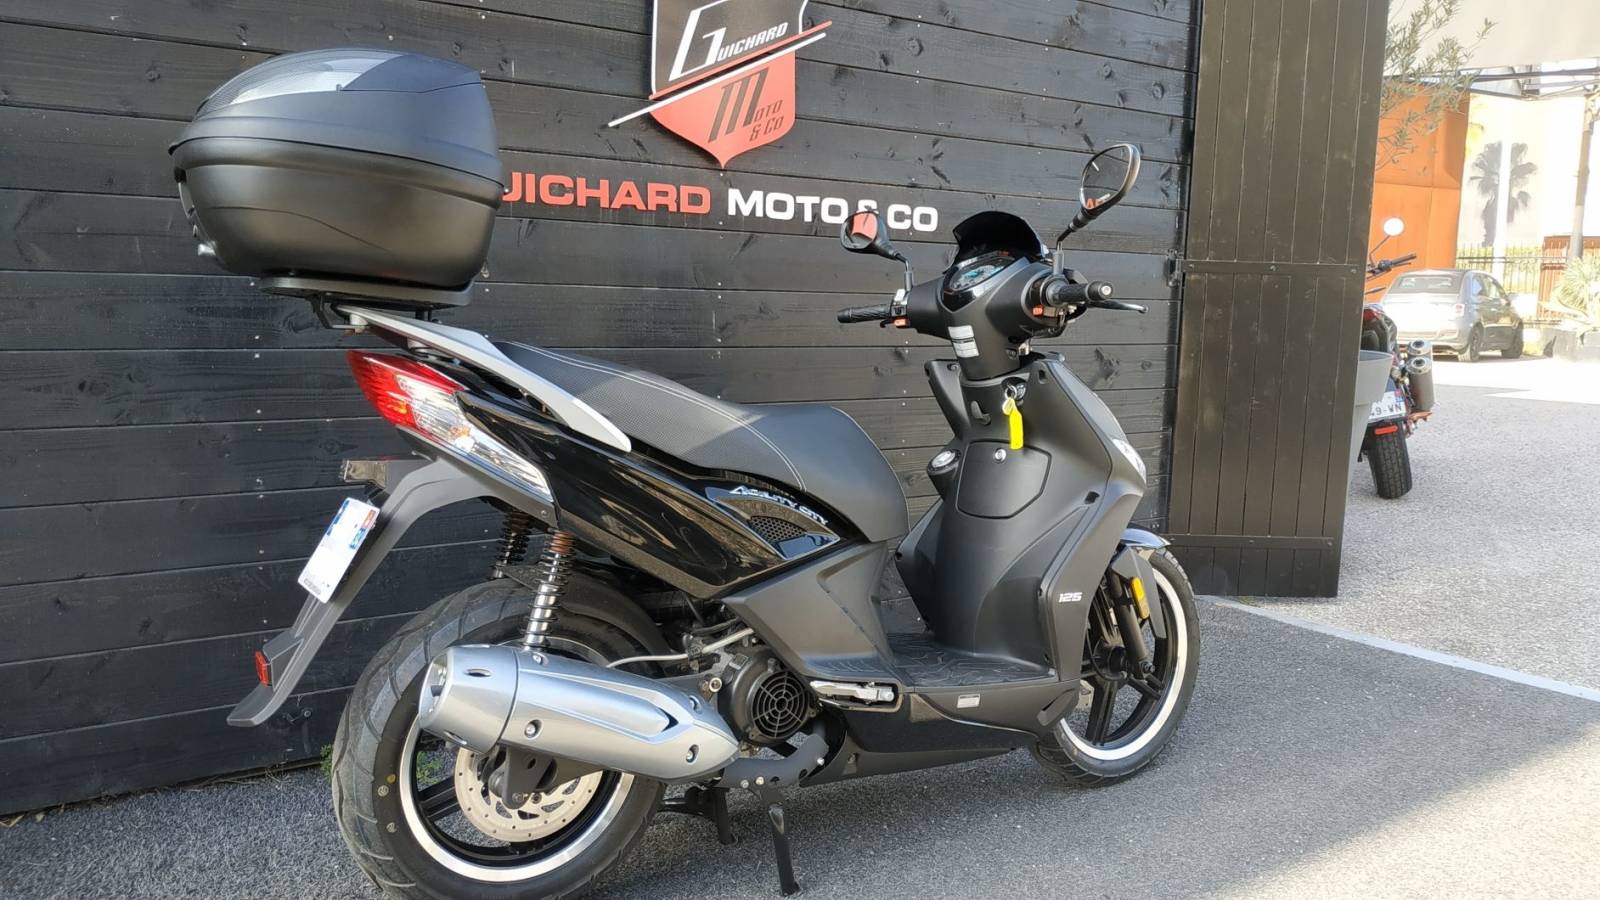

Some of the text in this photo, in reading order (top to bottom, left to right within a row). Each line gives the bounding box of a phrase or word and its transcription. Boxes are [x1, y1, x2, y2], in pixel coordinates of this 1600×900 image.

[764, 116, 784, 135] CO
[728, 188, 849, 224] MOTO
[887, 204, 938, 232] CO
[1058, 591, 1083, 603] 125
